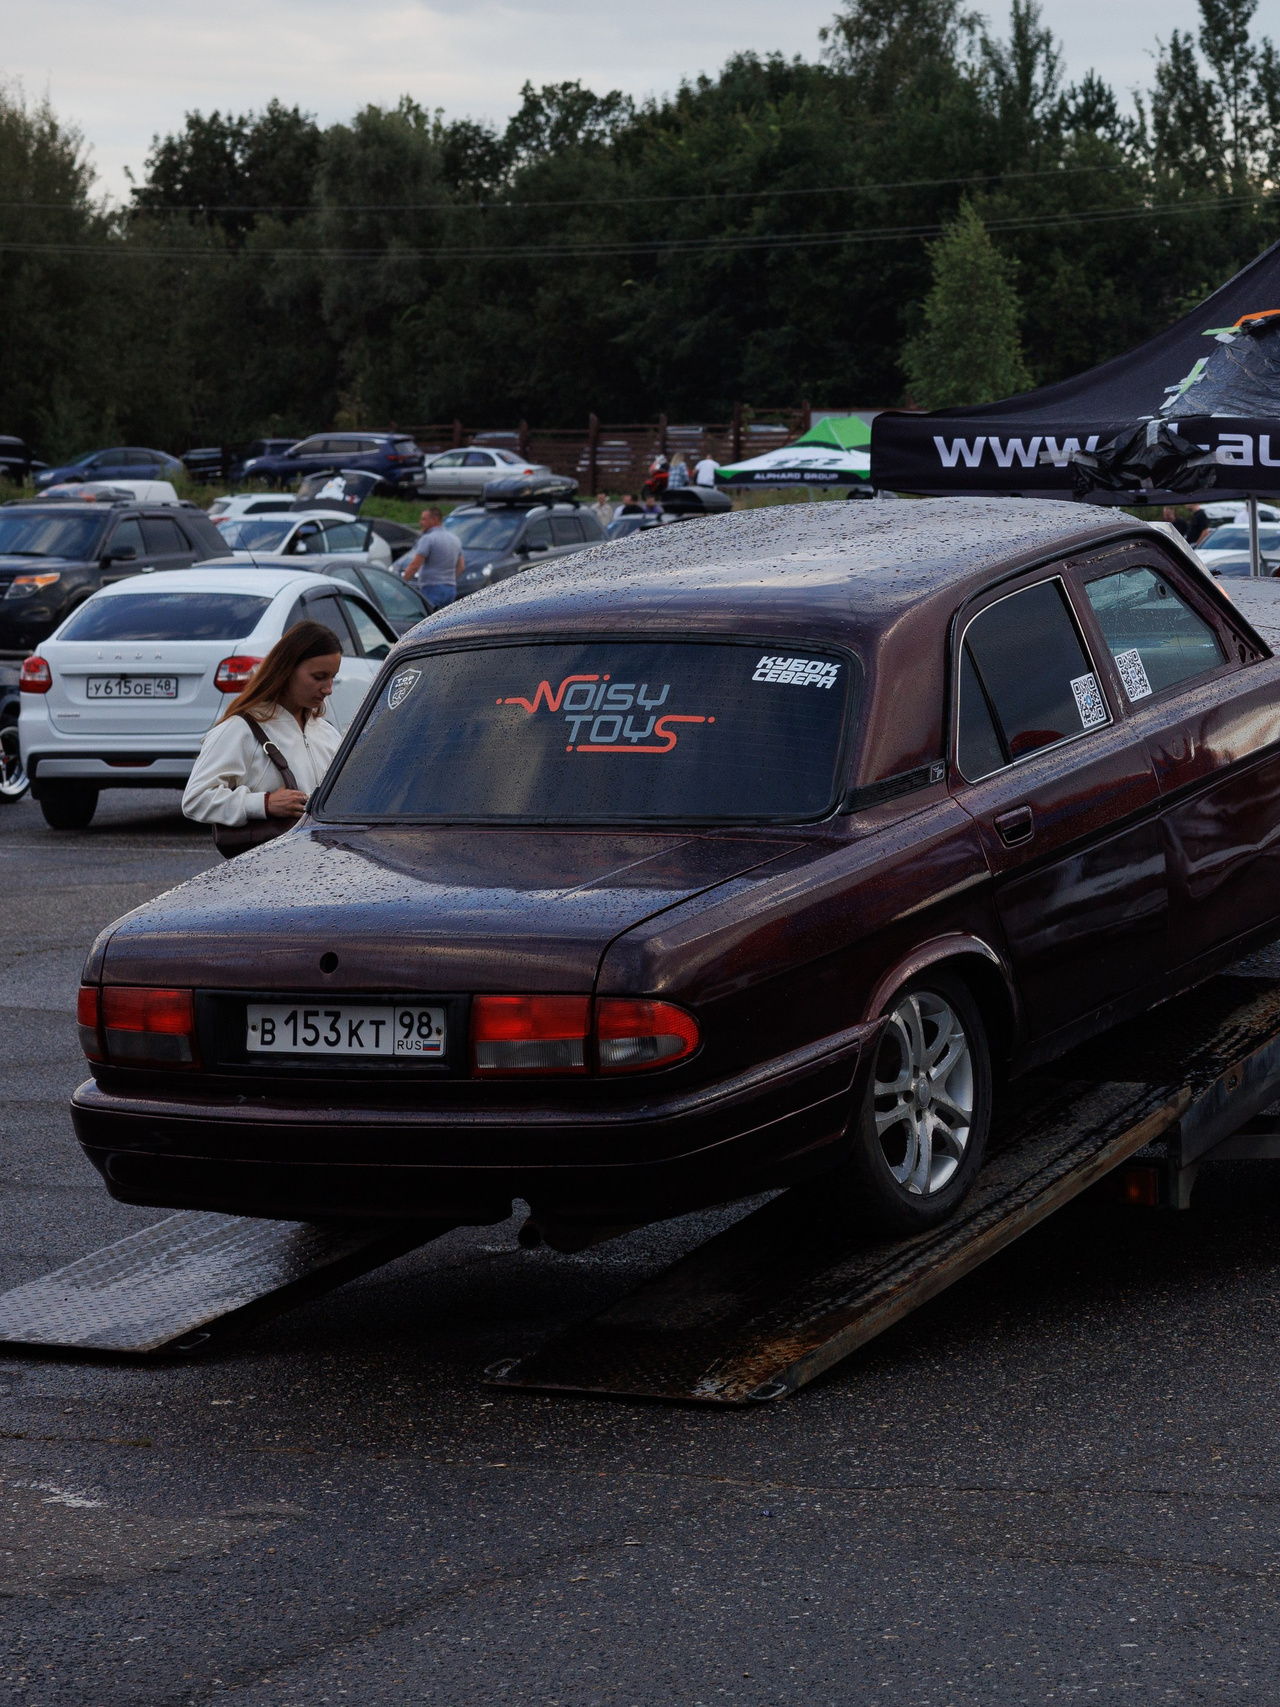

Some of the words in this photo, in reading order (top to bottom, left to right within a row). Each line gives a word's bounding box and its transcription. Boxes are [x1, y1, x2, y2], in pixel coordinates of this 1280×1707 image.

[754, 472, 802, 481] ALPHARD
[803, 472, 838, 481] GROUP
[756, 656, 841, 676] КУБОК
[156, 680, 172, 691] 48
[397, 675, 415, 684] TOP
[752, 668, 837, 689] СЕВЕРА
[564, 715, 708, 753] TOYS
[399, 1010, 433, 1039] 98
[397, 1040, 422, 1050] RUS
